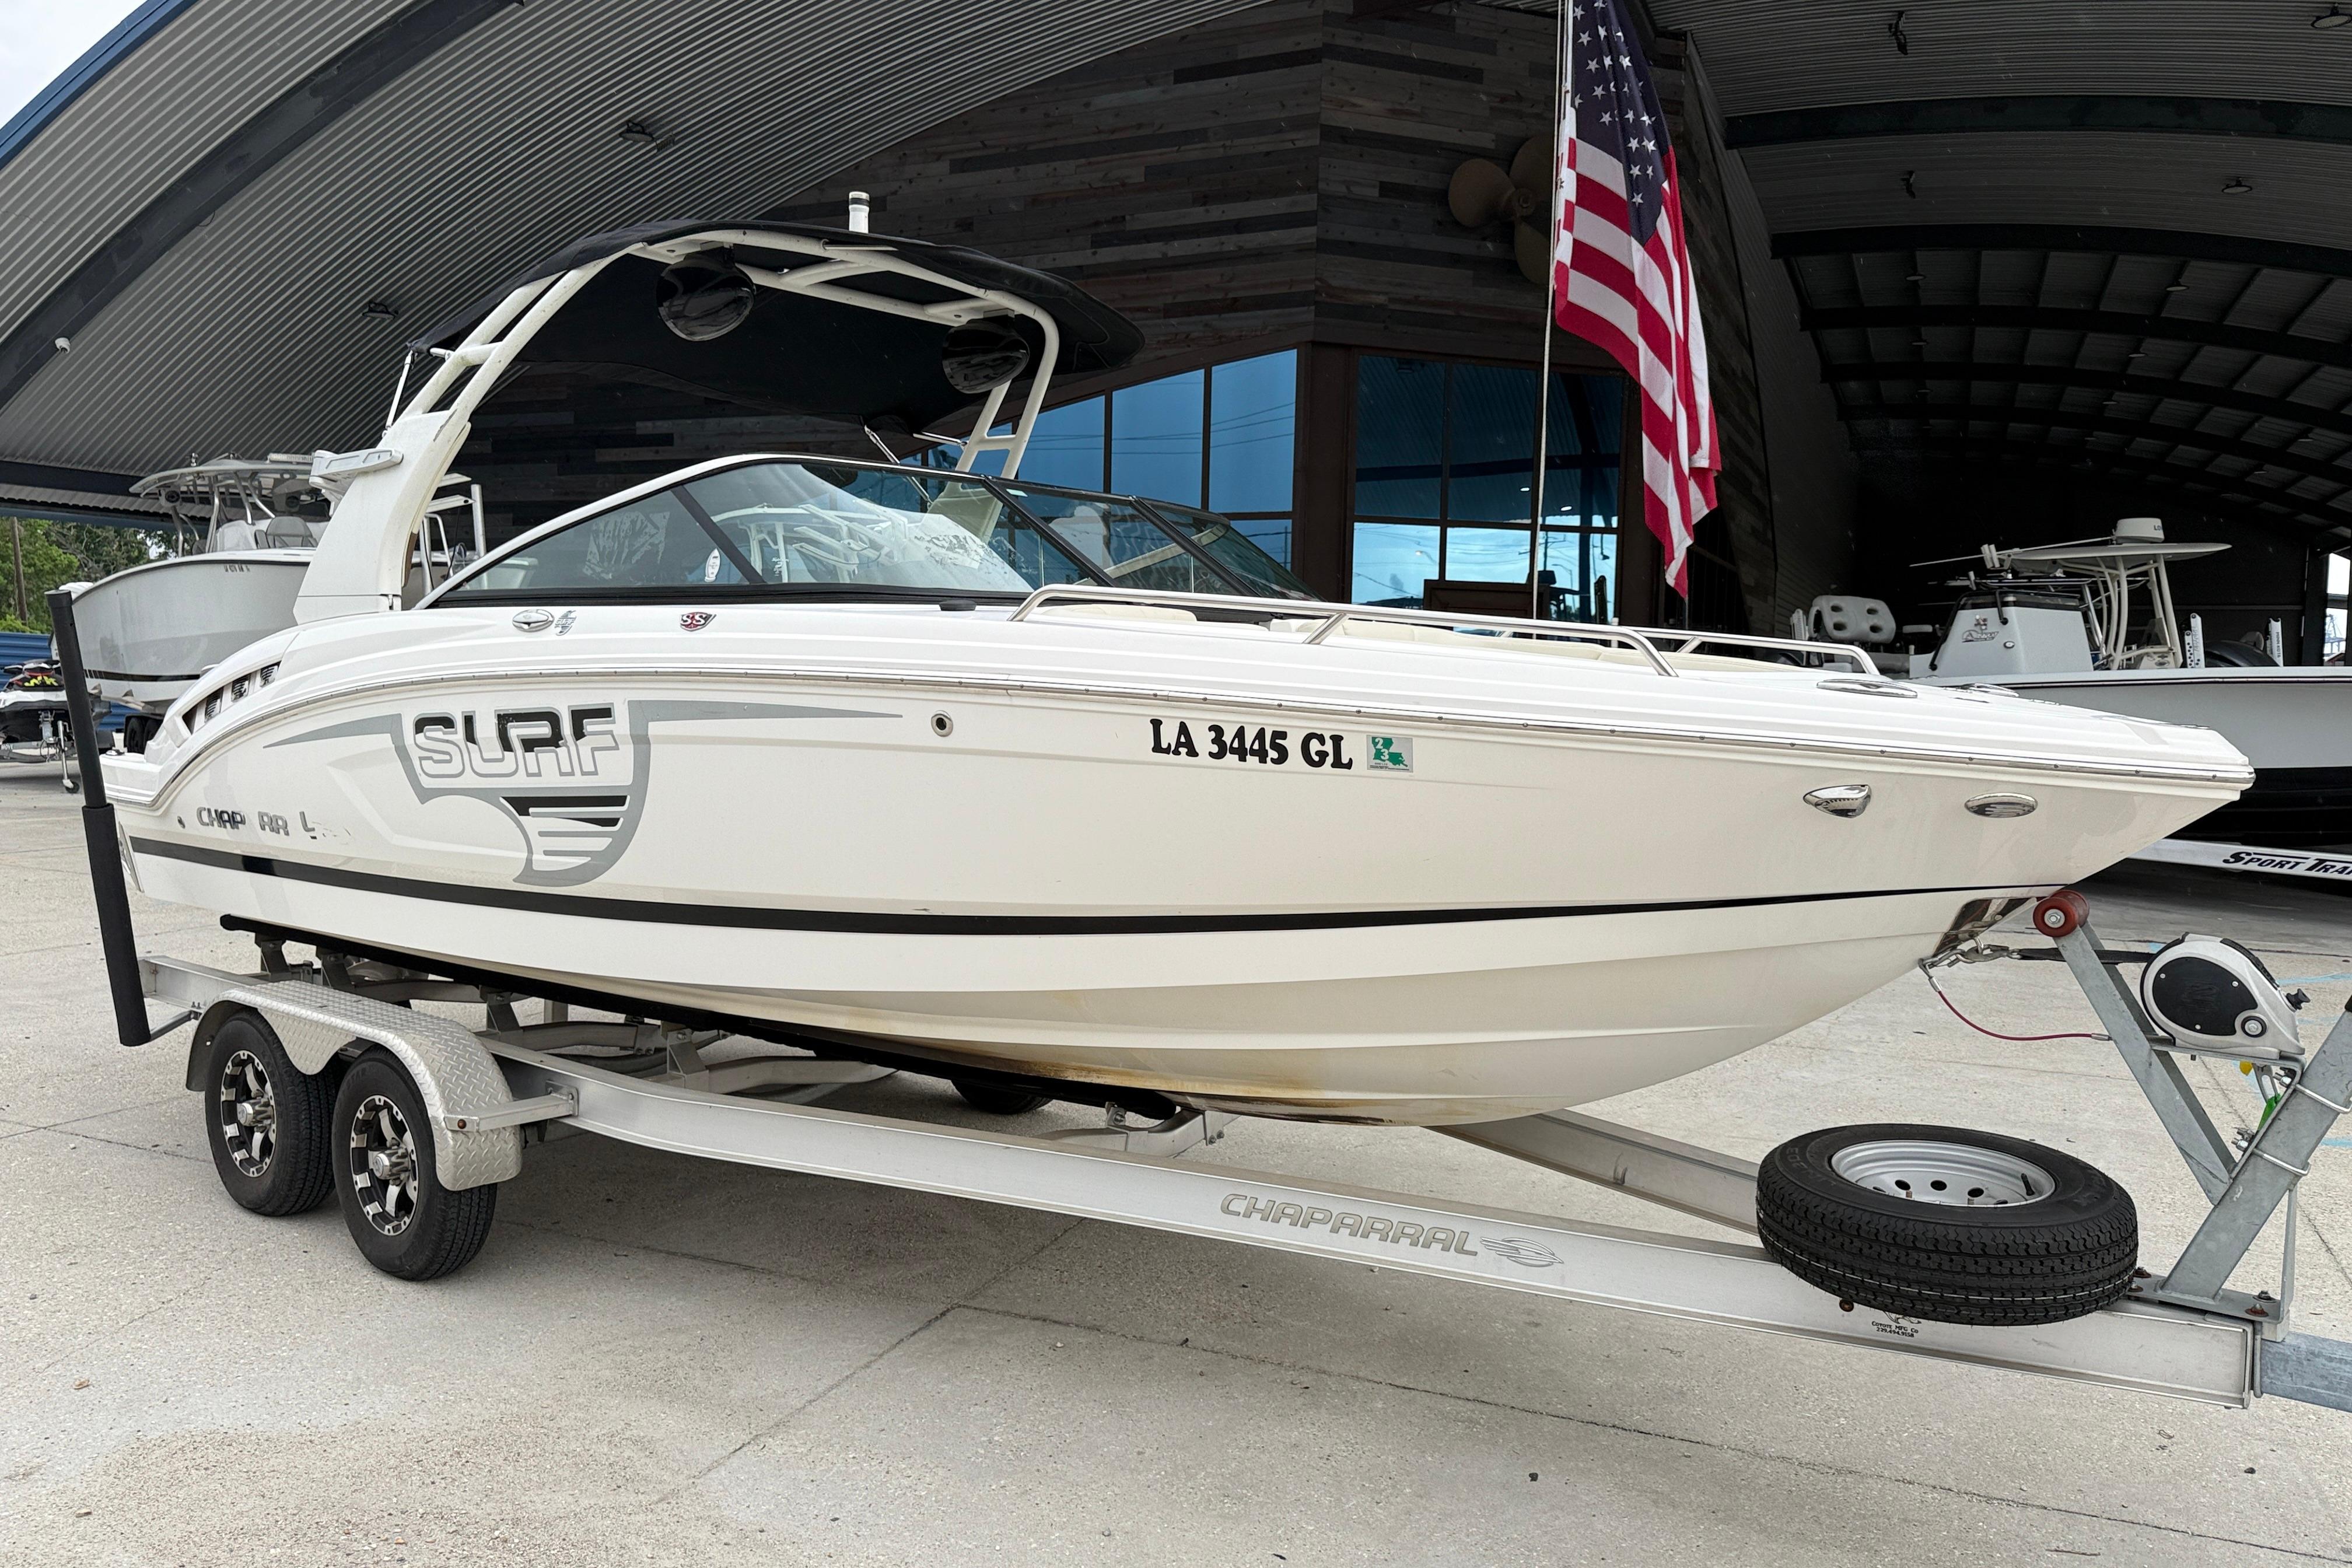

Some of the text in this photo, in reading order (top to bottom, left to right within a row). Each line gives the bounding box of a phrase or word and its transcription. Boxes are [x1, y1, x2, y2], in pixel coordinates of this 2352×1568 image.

[680, 614, 706, 625] SS
[413, 703, 620, 778] SURF
[1150, 719, 1353, 770] LA 3445 GL
[2222, 851, 2308, 870] SPORT
[1220, 1193, 1478, 1256] CHAPARRAL
[1871, 1321, 1892, 1329] COYOTE
